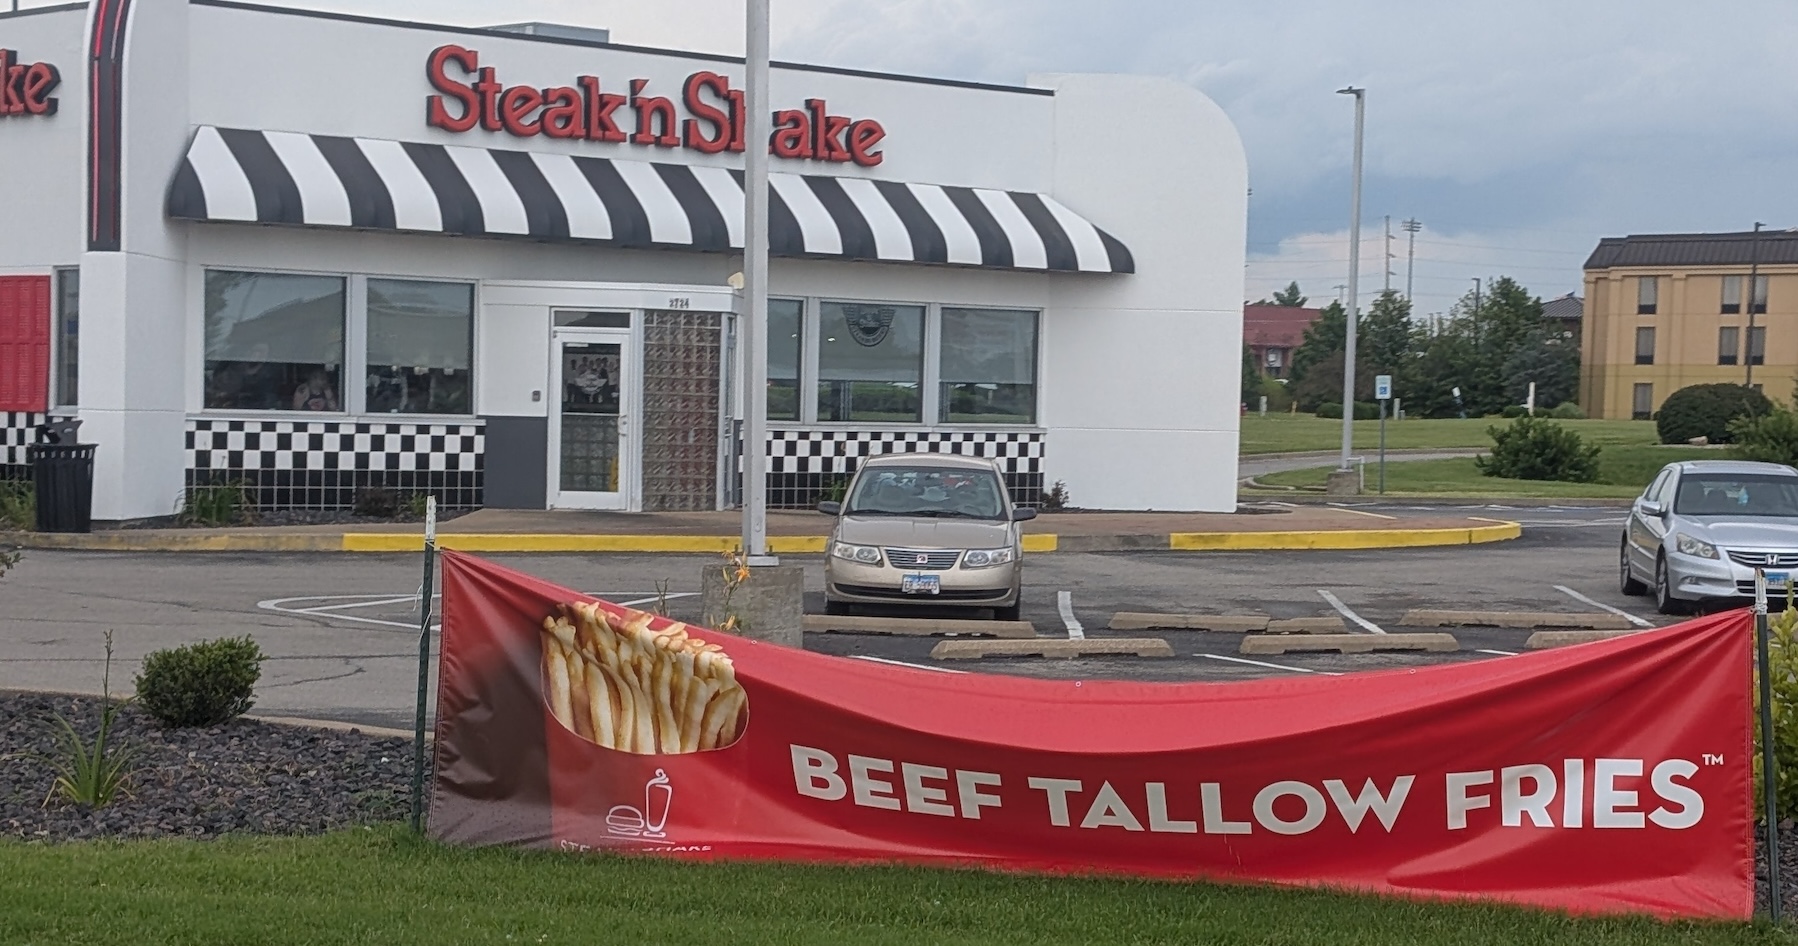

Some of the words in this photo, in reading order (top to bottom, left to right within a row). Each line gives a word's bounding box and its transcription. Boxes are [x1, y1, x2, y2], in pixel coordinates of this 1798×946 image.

[669, 297, 690, 309] 2724
[789, 744, 1002, 819] BEEF
[1027, 775, 1416, 835] TALLOW
[1446, 758, 1705, 829] FRIES
